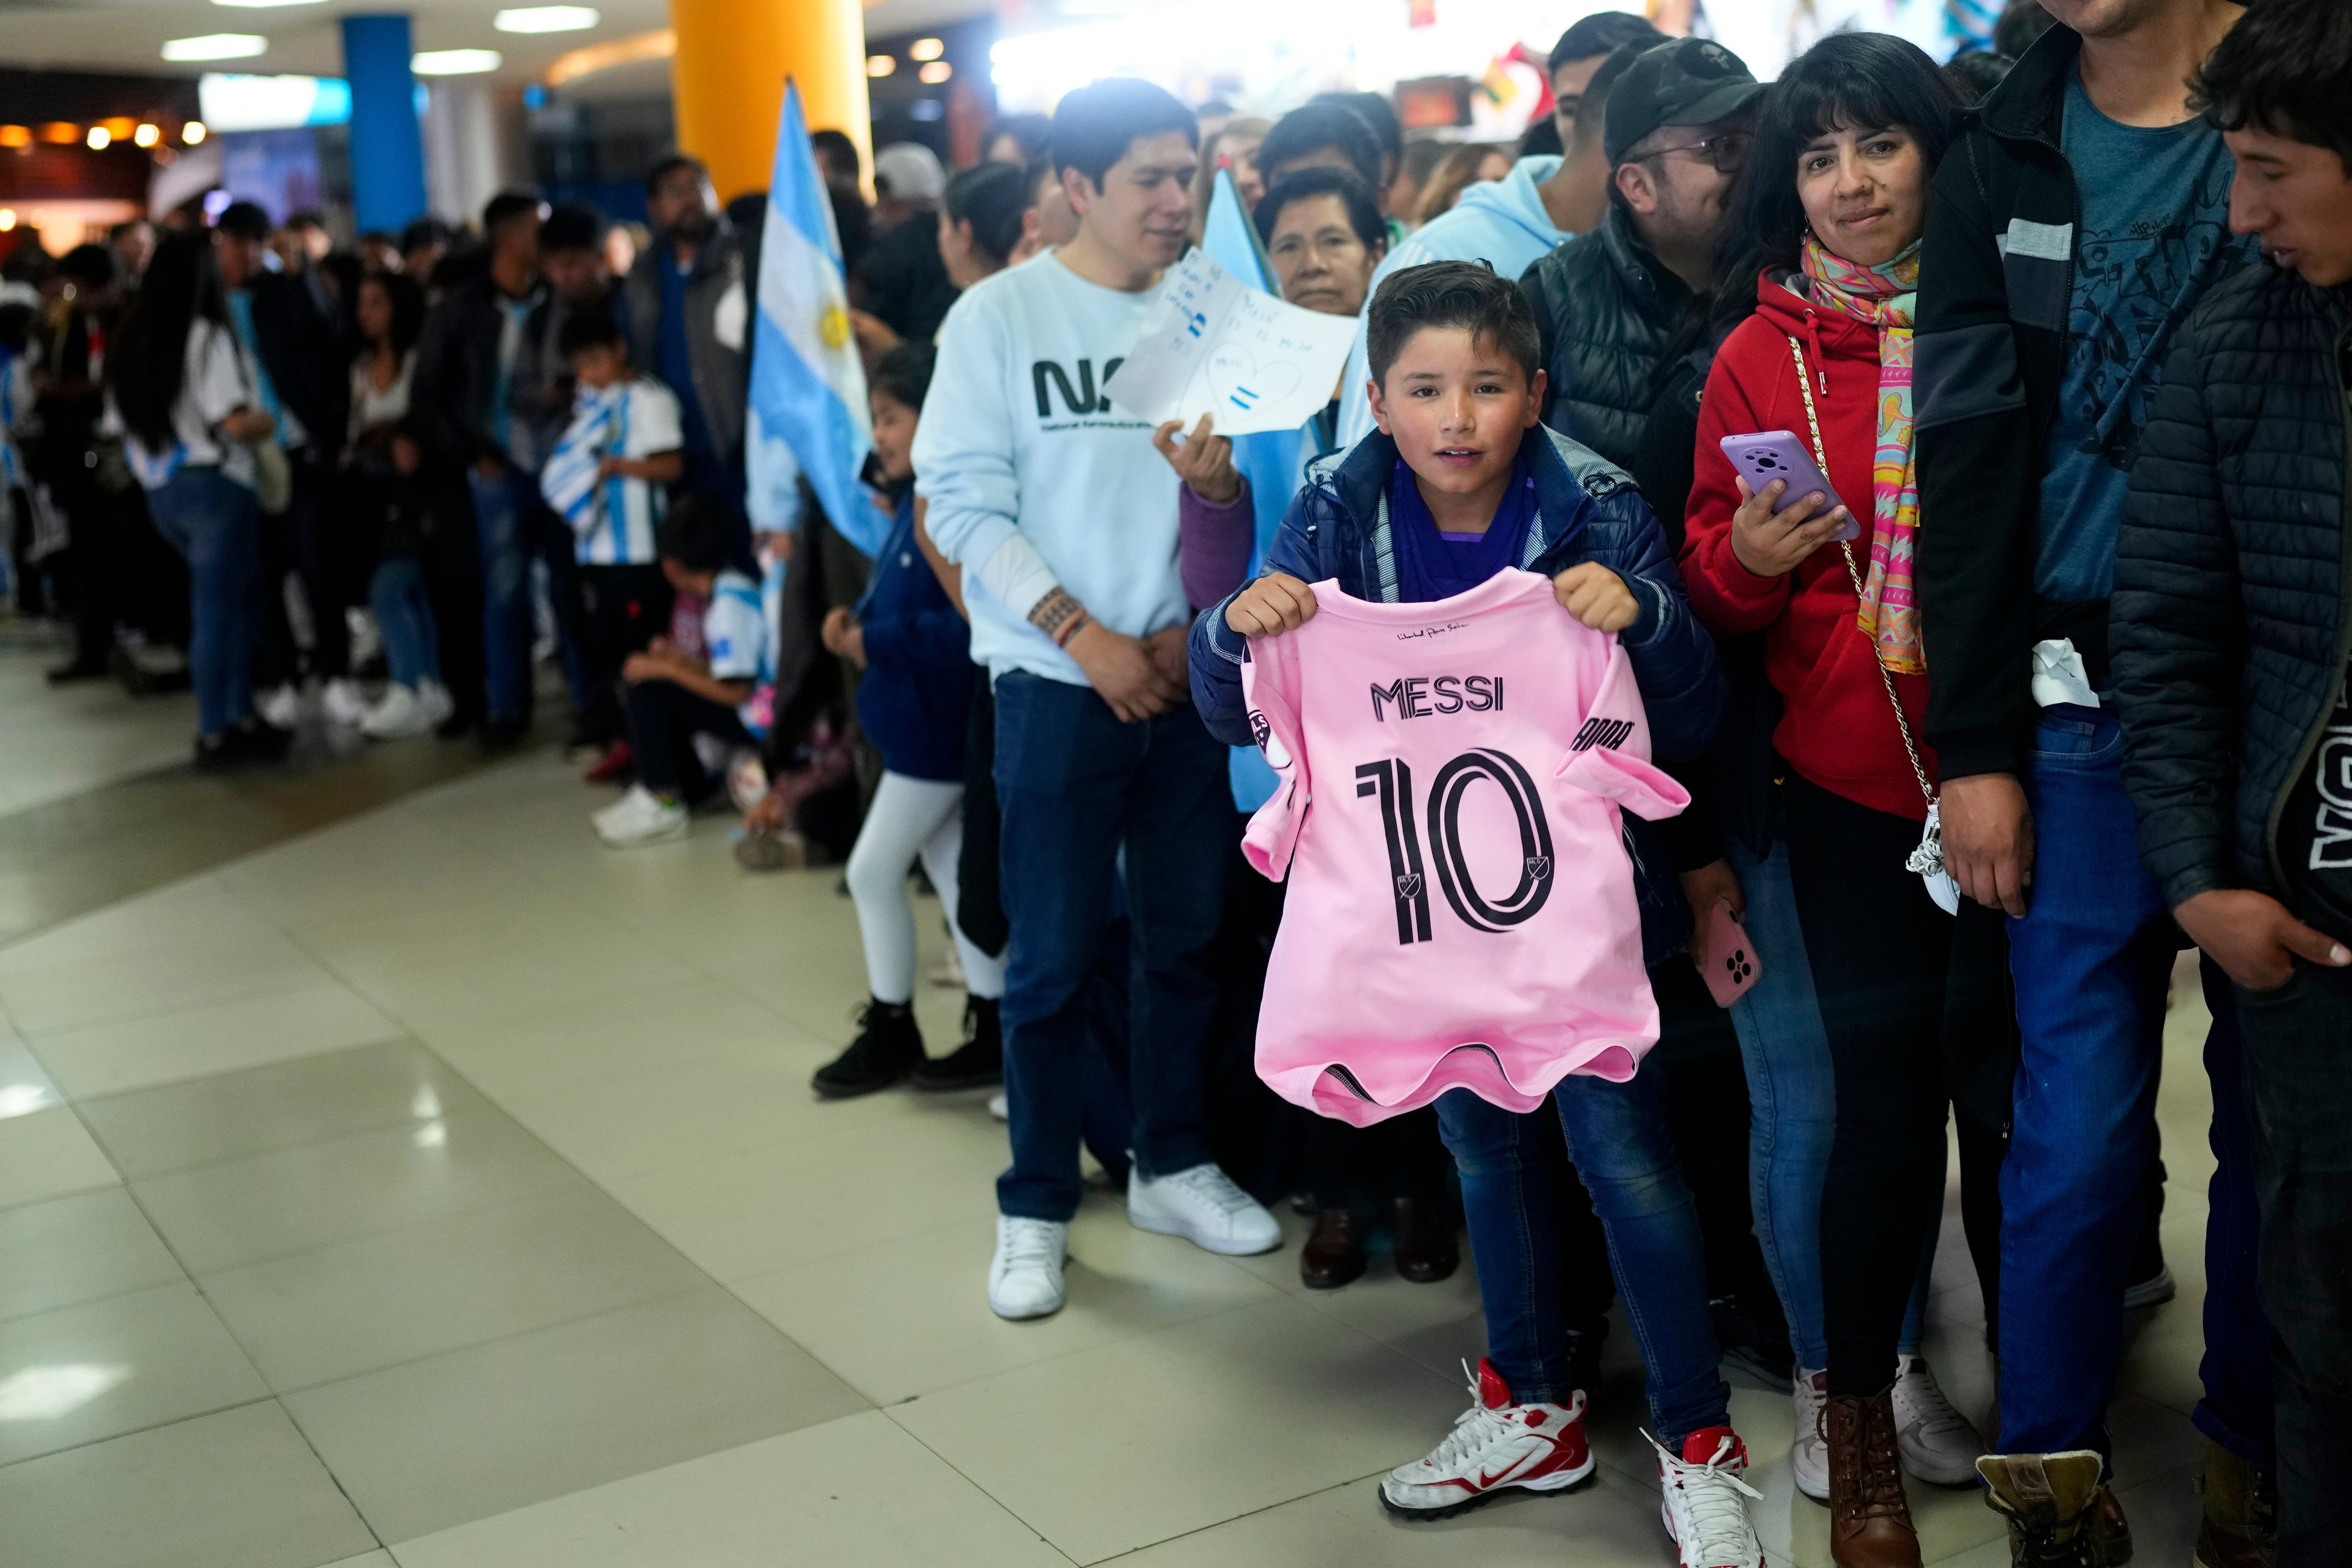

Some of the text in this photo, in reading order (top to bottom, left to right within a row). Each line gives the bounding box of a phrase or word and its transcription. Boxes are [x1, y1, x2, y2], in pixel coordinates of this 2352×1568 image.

[1370, 676, 1503, 722] MESSI
[1249, 715, 1268, 733] LS
[1355, 748, 1555, 946] 10
